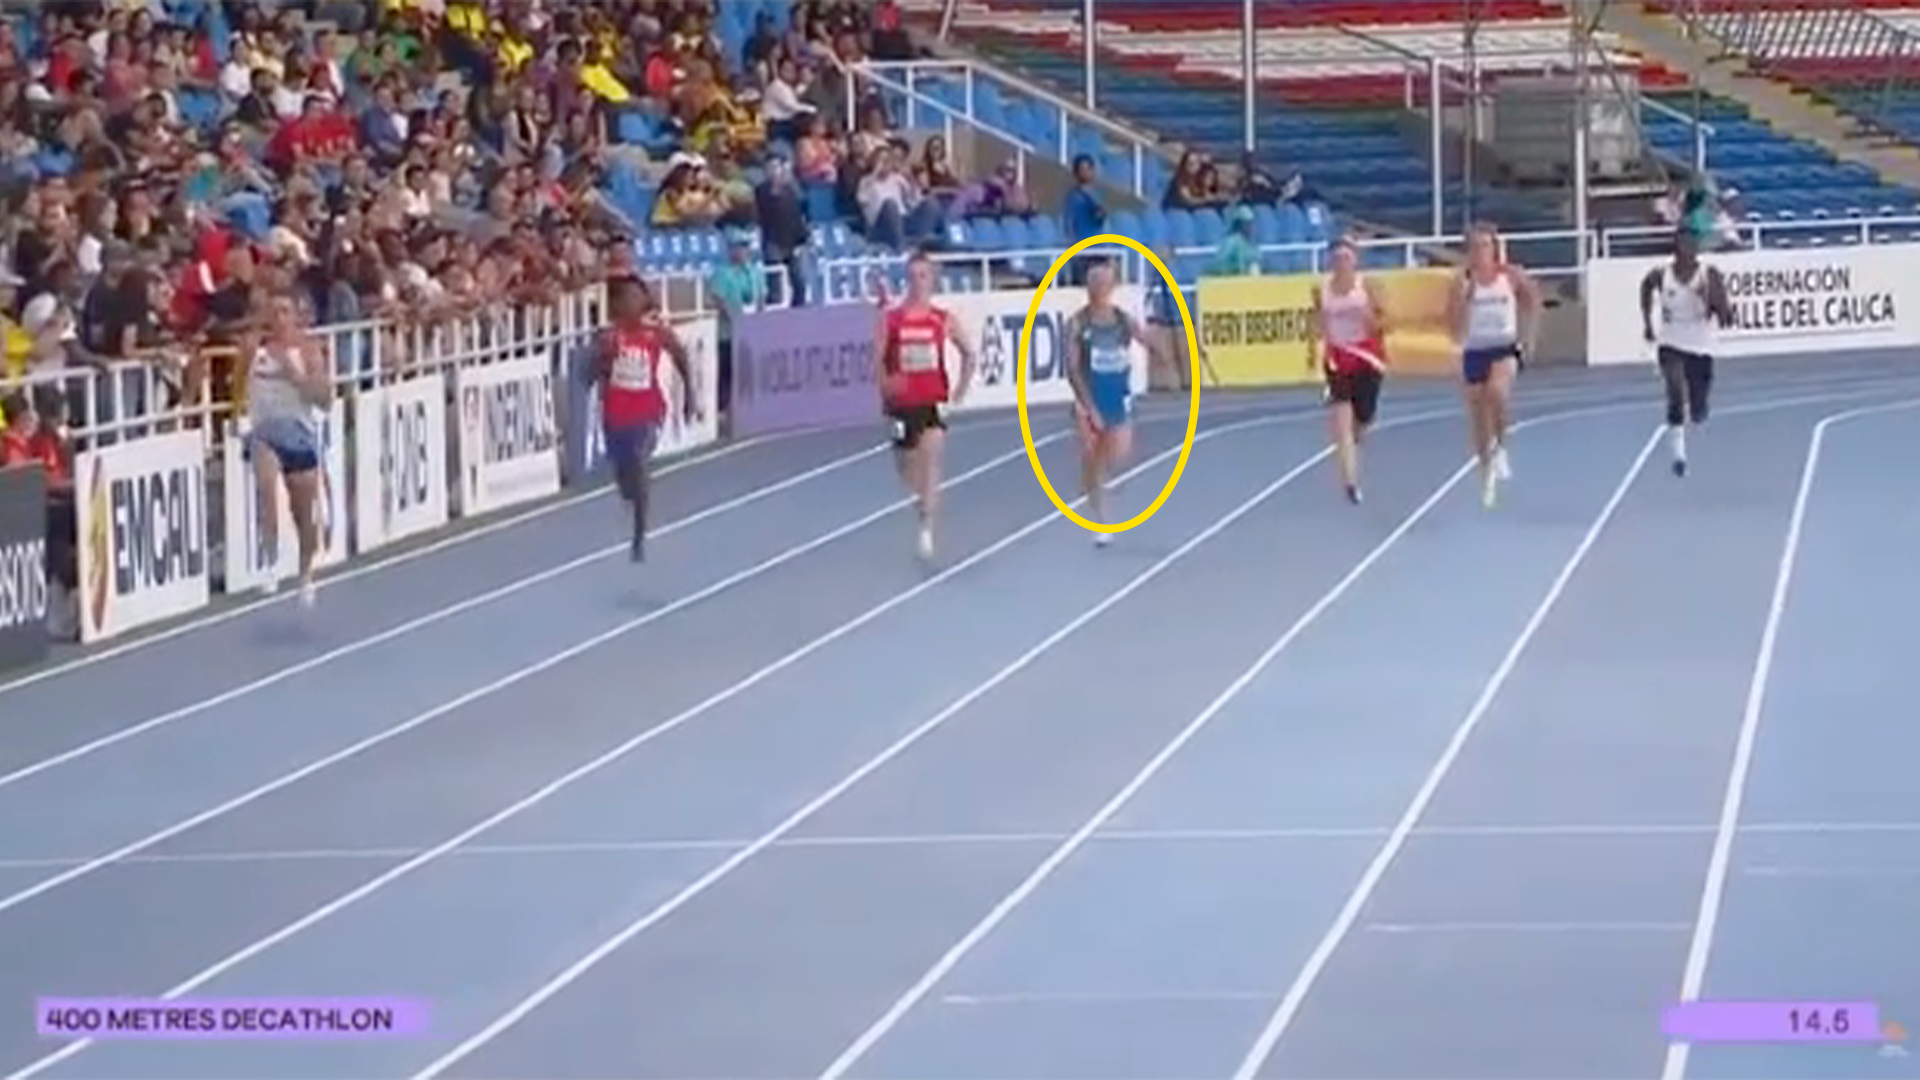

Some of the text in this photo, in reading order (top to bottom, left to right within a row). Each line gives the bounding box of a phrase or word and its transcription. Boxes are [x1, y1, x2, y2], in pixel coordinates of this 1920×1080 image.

[1724, 266, 1850, 298] OBERNACIÓN
[1202, 311, 1242, 346] EVERY
[1245, 309, 1295, 344] BREATH
[1728, 293, 1896, 331] ALLE DEL CAUCA
